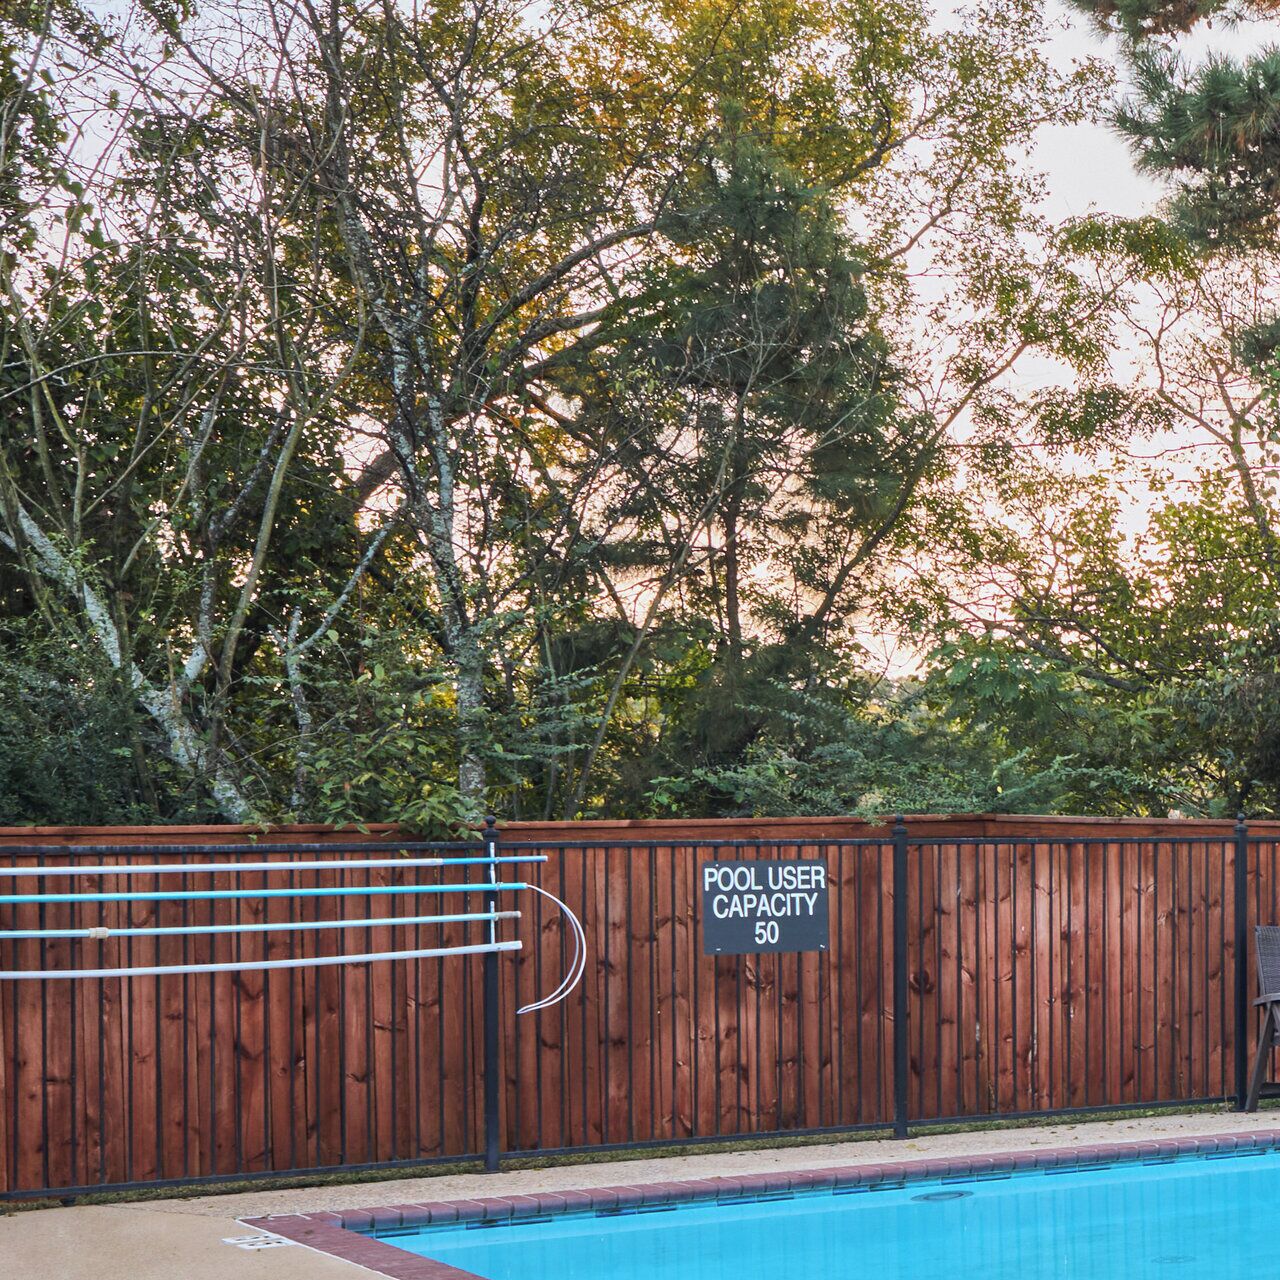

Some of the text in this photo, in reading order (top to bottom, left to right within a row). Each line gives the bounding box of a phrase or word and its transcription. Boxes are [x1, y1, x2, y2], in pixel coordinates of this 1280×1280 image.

[704, 866, 826, 891] POOL USER
[713, 892, 818, 918] CAPACITY
[755, 921, 779, 944] 50
